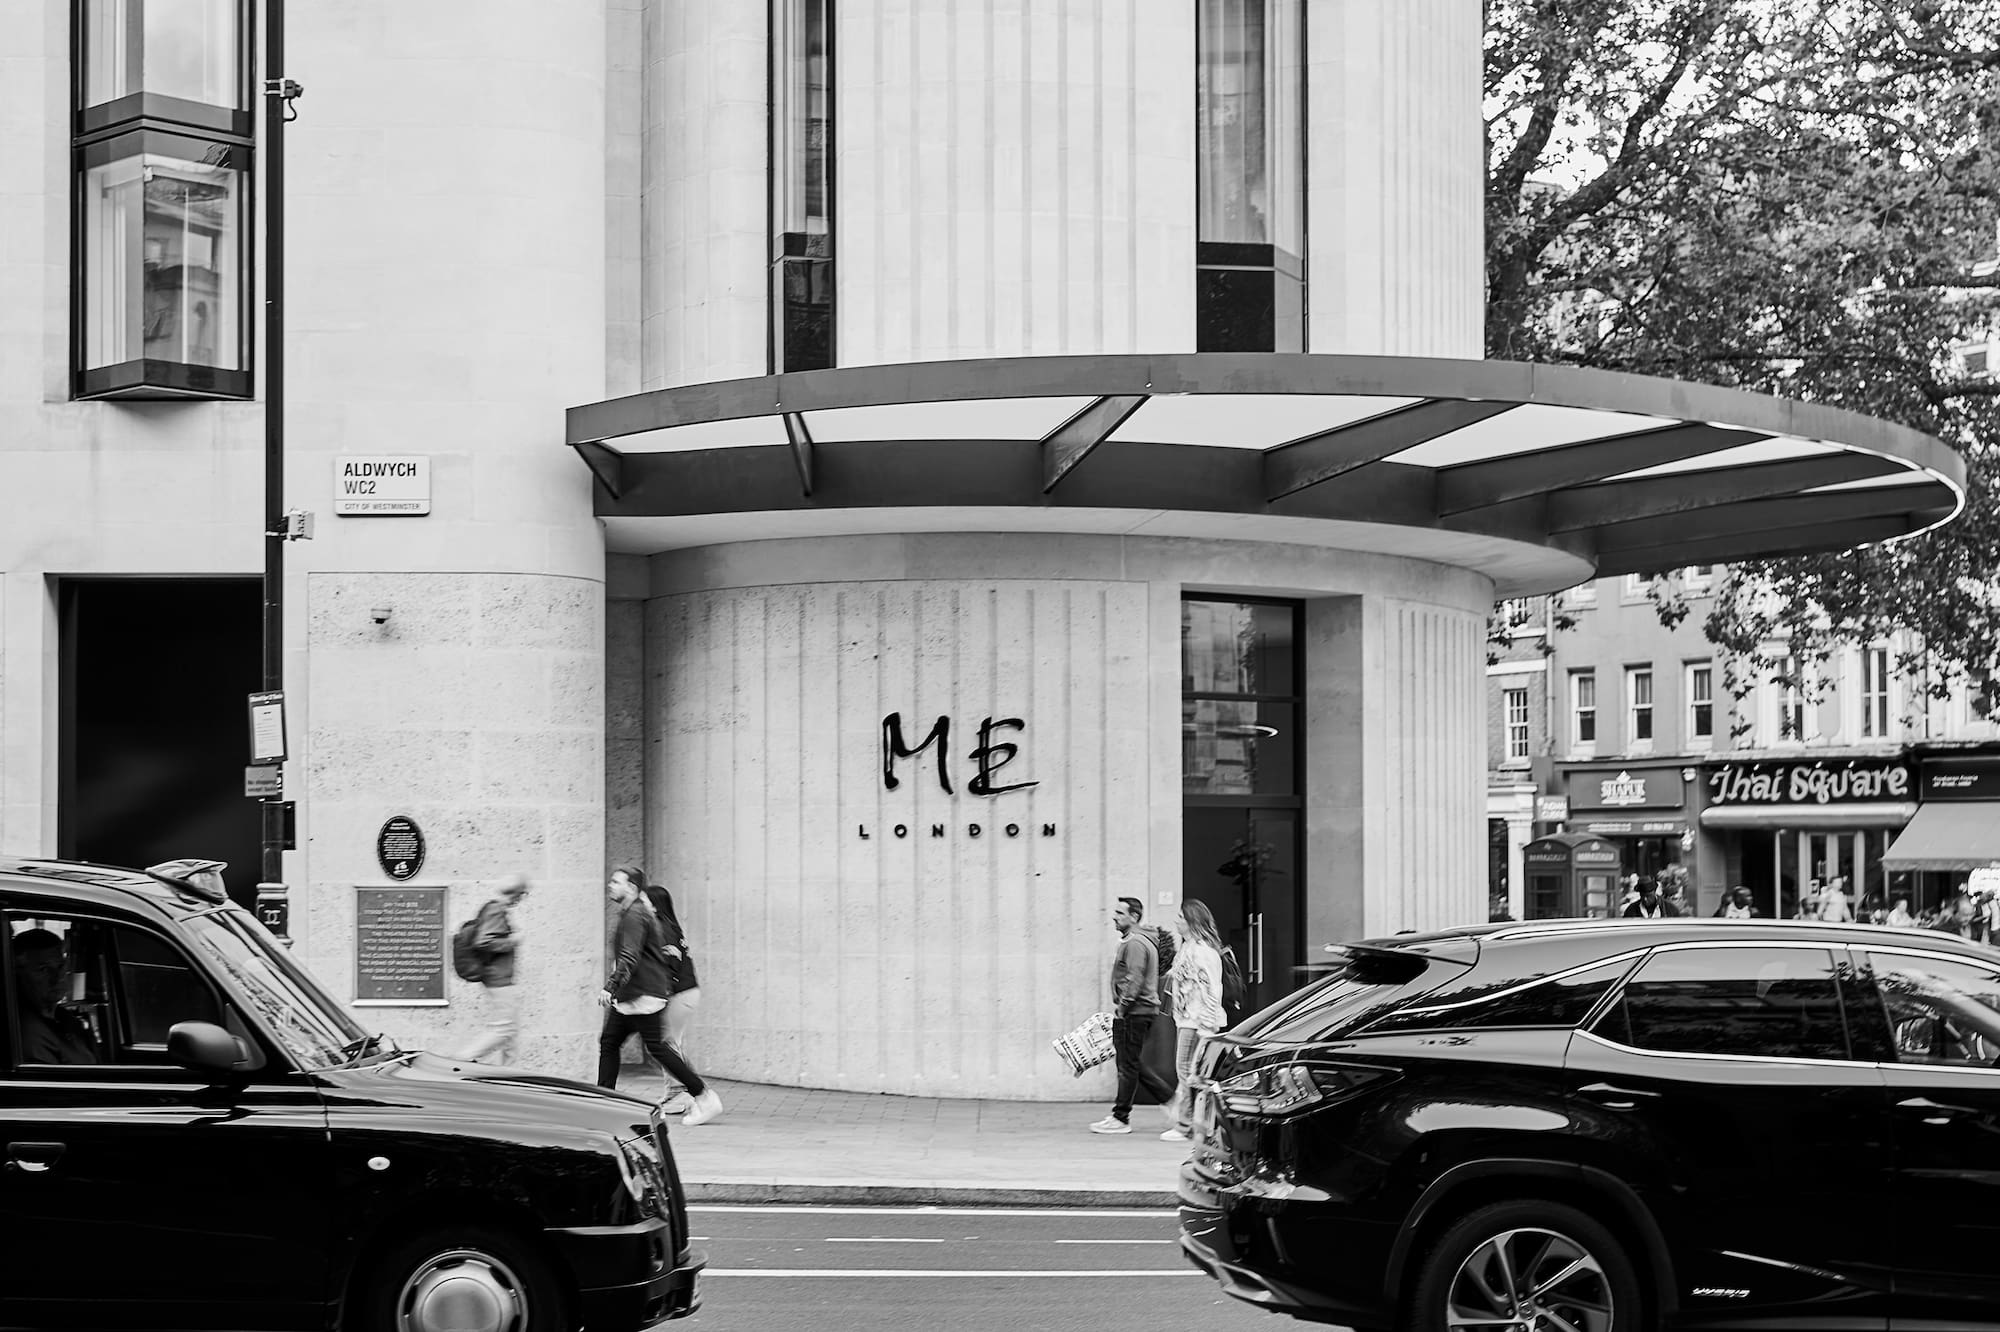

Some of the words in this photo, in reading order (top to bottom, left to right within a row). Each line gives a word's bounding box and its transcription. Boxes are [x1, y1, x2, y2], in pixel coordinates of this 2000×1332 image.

[344, 462, 417, 477] ALDWYCH
[344, 480, 377, 494] WC2
[882, 712, 1041, 795] ME
[1709, 763, 1784, 804] Thai
[1789, 761, 1908, 804] Square
[859, 823, 1056, 839] LONDON
